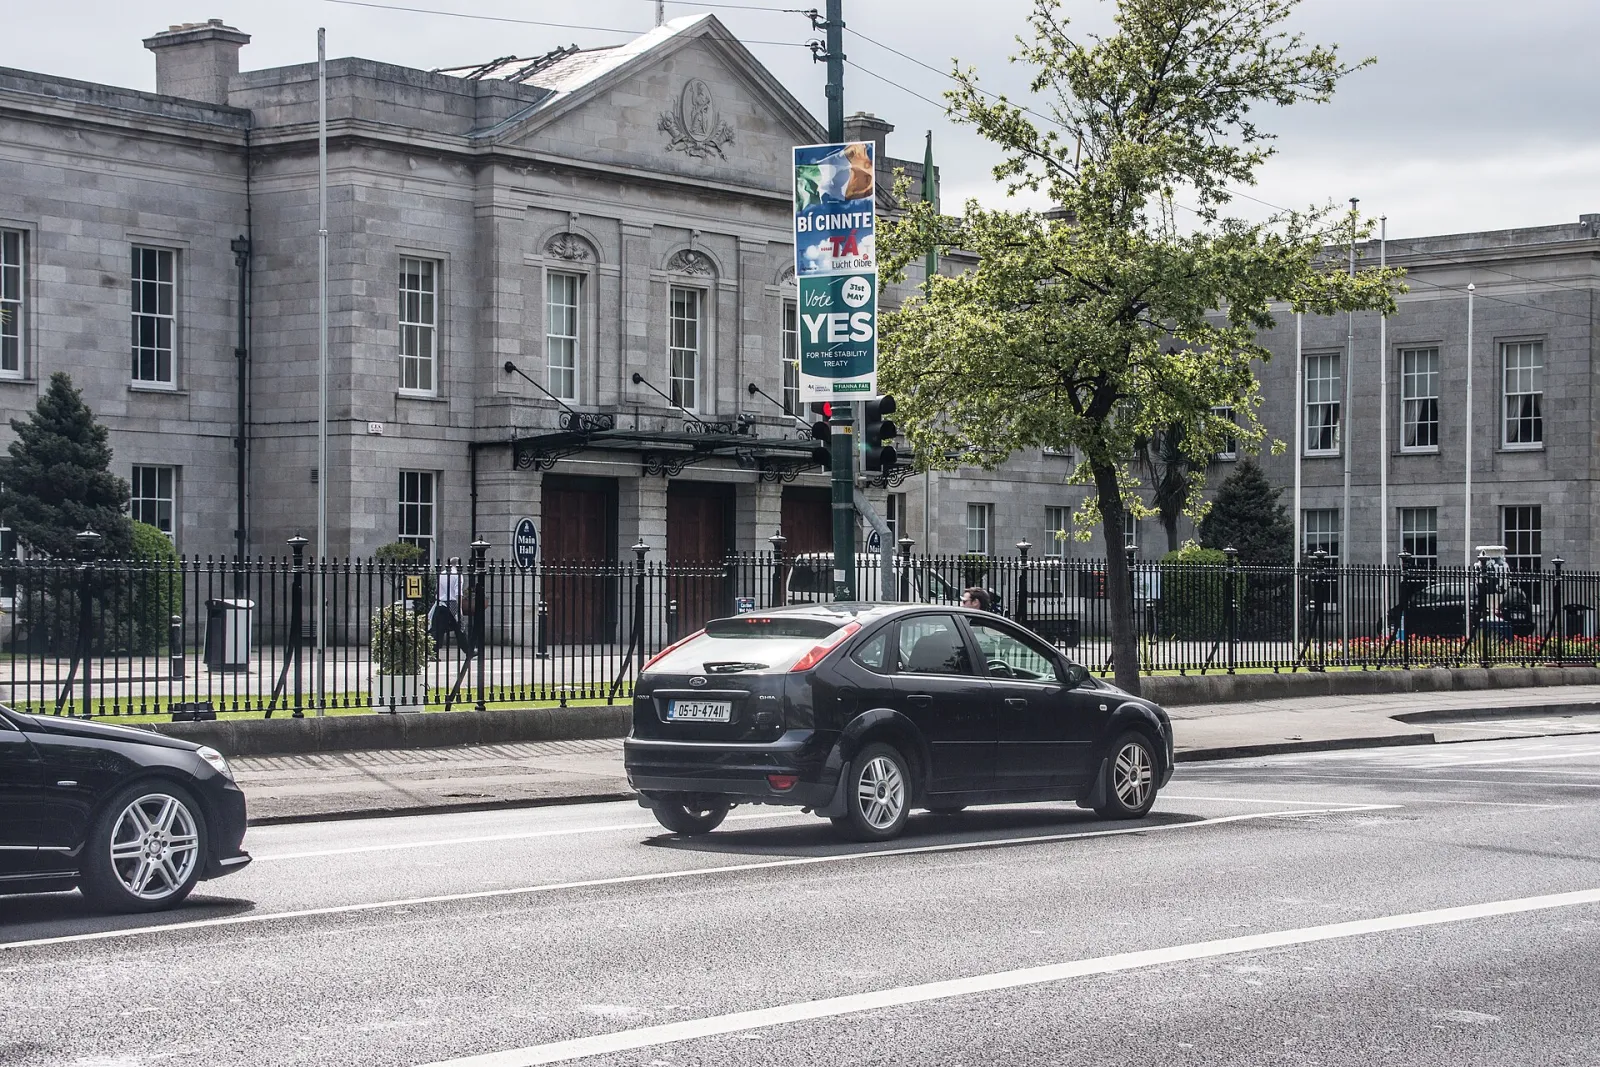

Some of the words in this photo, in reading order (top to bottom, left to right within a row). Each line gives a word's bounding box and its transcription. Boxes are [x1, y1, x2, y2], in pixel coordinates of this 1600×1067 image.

[797, 212, 813, 232] BÍ
[815, 212, 872, 231] CINNTE
[829, 229, 859, 257] TÁ
[831, 260, 852, 269] Lucht
[853, 258, 872, 268] Oibre
[849, 283, 865, 292] 31st
[805, 289, 834, 307] Vote
[846, 293, 864, 301] MAY
[801, 312, 873, 343] YES
[834, 350, 868, 358] STABILITY
[518, 536, 535, 544] Main
[519, 546, 534, 554] Hall
[678, 704, 724, 718] 05-D-47411
